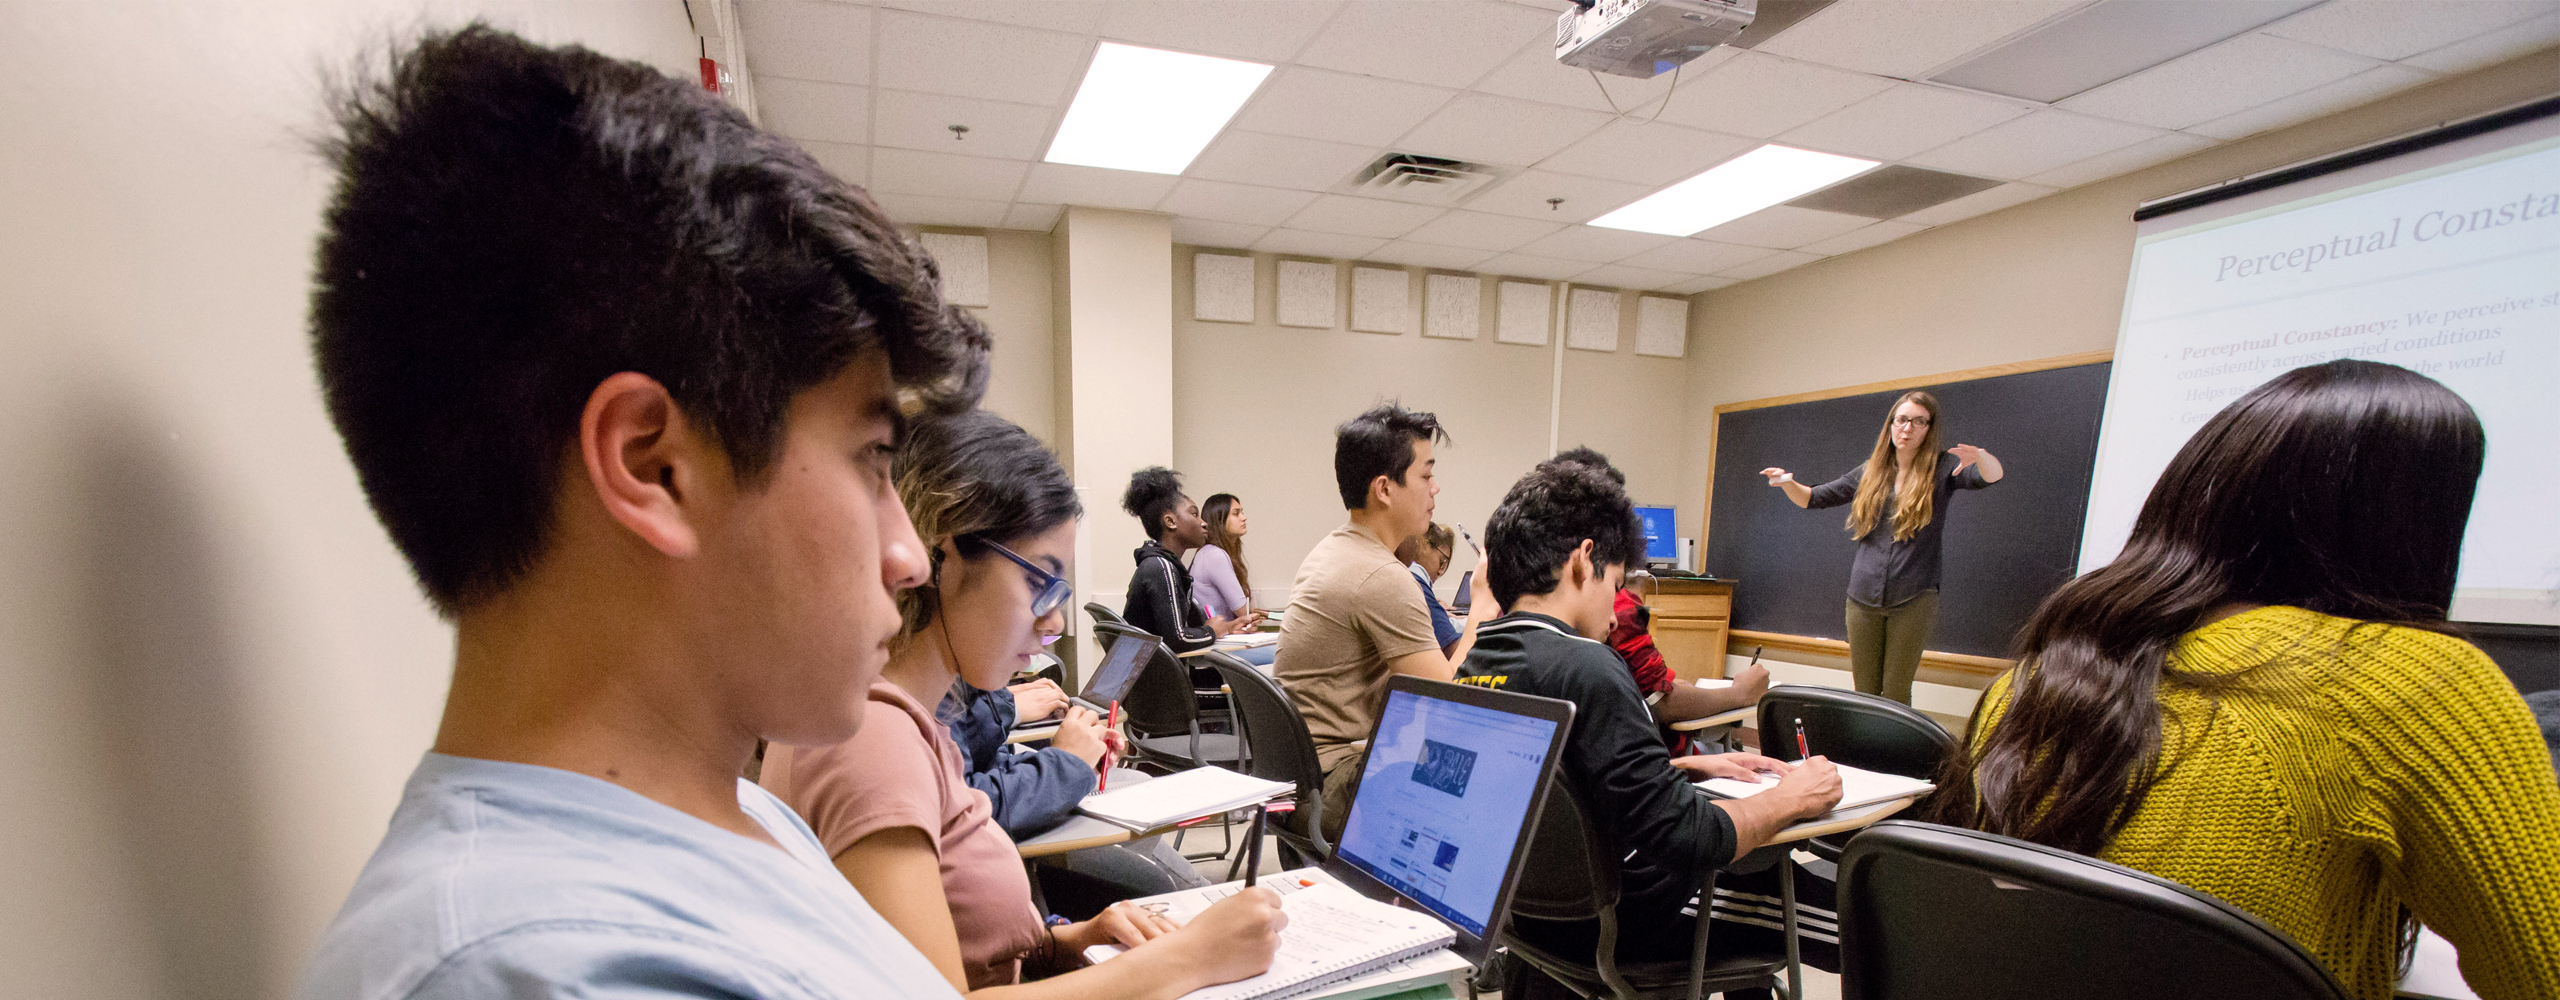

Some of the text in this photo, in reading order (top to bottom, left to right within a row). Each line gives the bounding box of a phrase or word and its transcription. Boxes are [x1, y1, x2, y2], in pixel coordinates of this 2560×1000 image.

[2214, 217, 2402, 283] Perceptual
[2177, 327, 2502, 381] consistently across varied conditions
[2181, 333, 2279, 361] Perceptual
[2284, 319, 2398, 346] Constancy:
[2407, 310, 2438, 327] We
[2442, 296, 2534, 326] perceive
[2186, 387, 2224, 403] Helps
[2228, 385, 2244, 397] us
[2413, 359, 2442, 373] the
[2448, 349, 2505, 371] world
